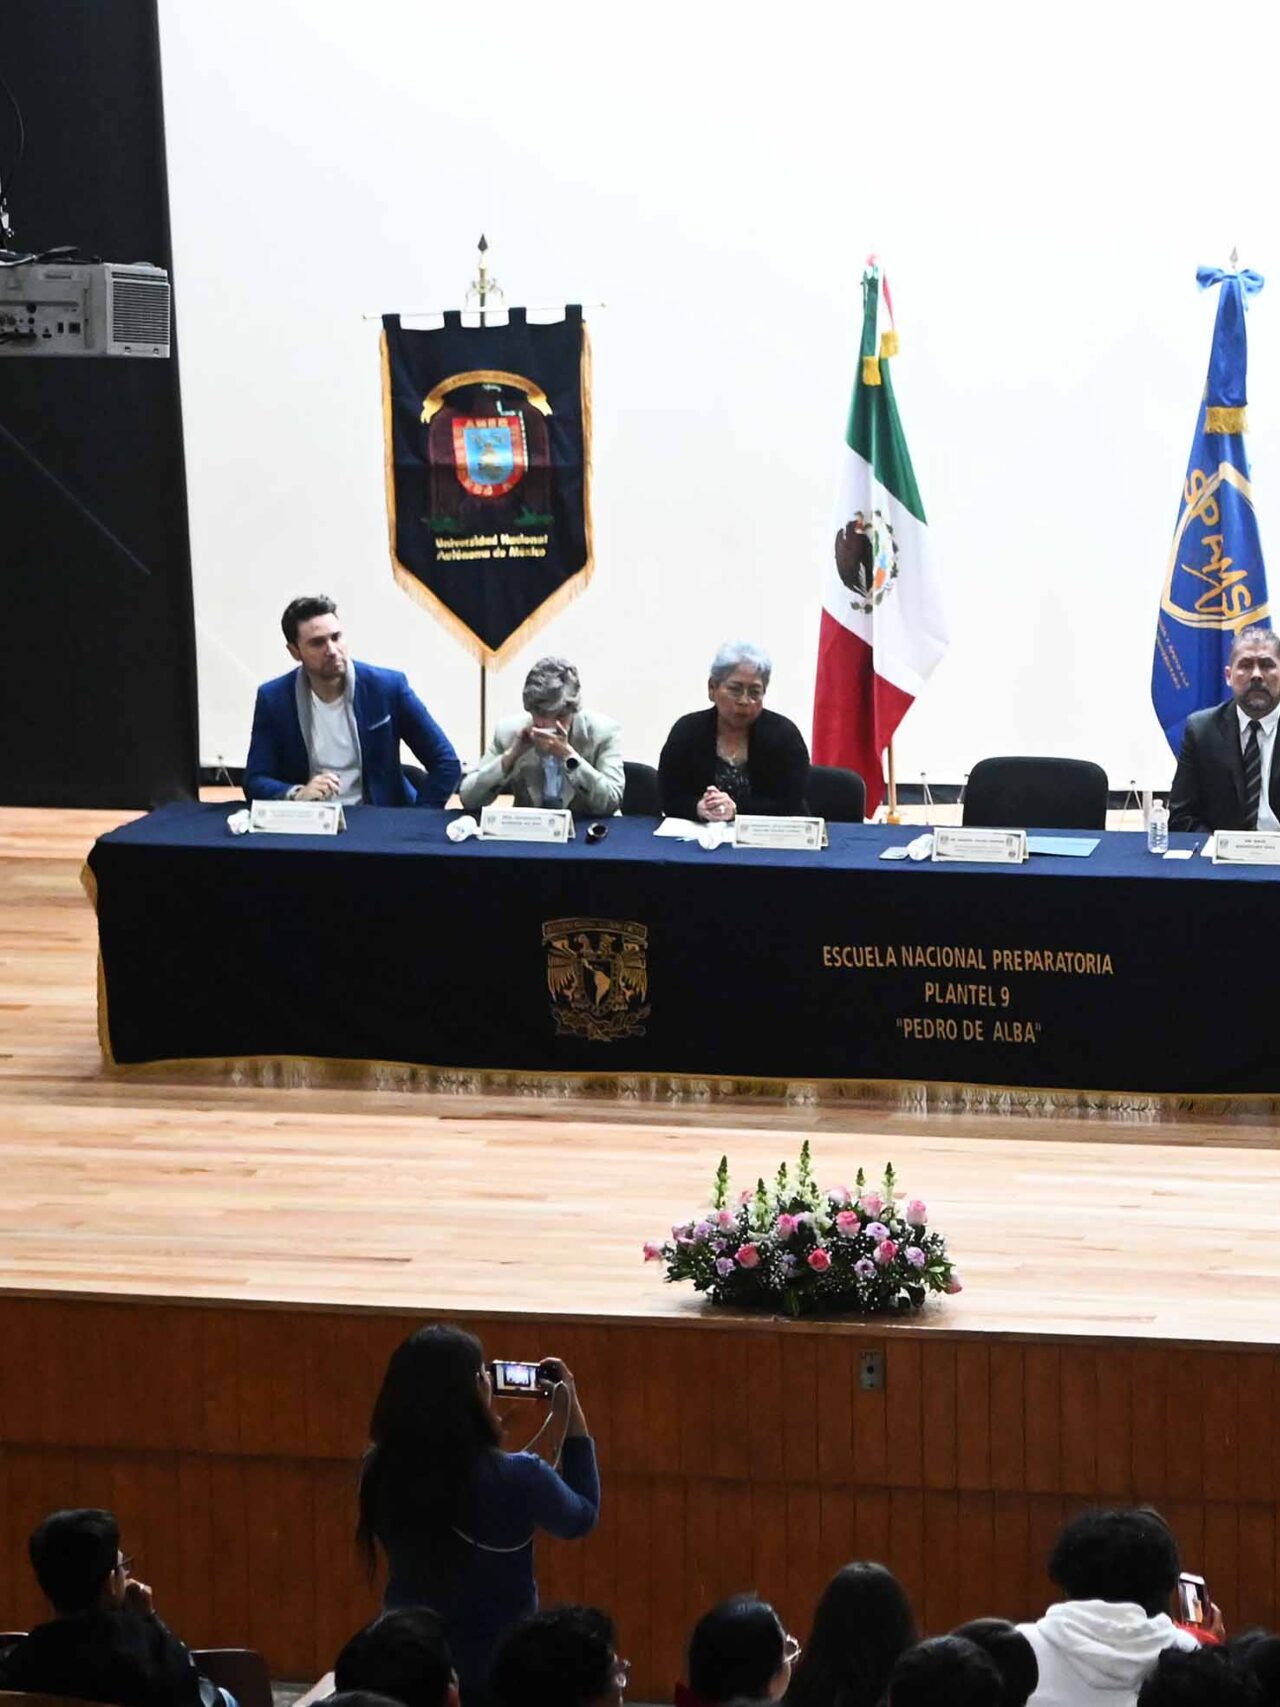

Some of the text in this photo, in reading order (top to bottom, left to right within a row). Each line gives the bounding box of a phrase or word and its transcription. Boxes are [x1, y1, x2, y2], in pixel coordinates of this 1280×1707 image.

[435, 533, 548, 549] Universidad Nacional
[492, 547, 507, 559] de
[822, 945, 1114, 976] ESCUELA NACIONAL PREPARATORIA
[924, 981, 1011, 1008] PLANTEL 9
[963, 1018, 985, 1041] DE
